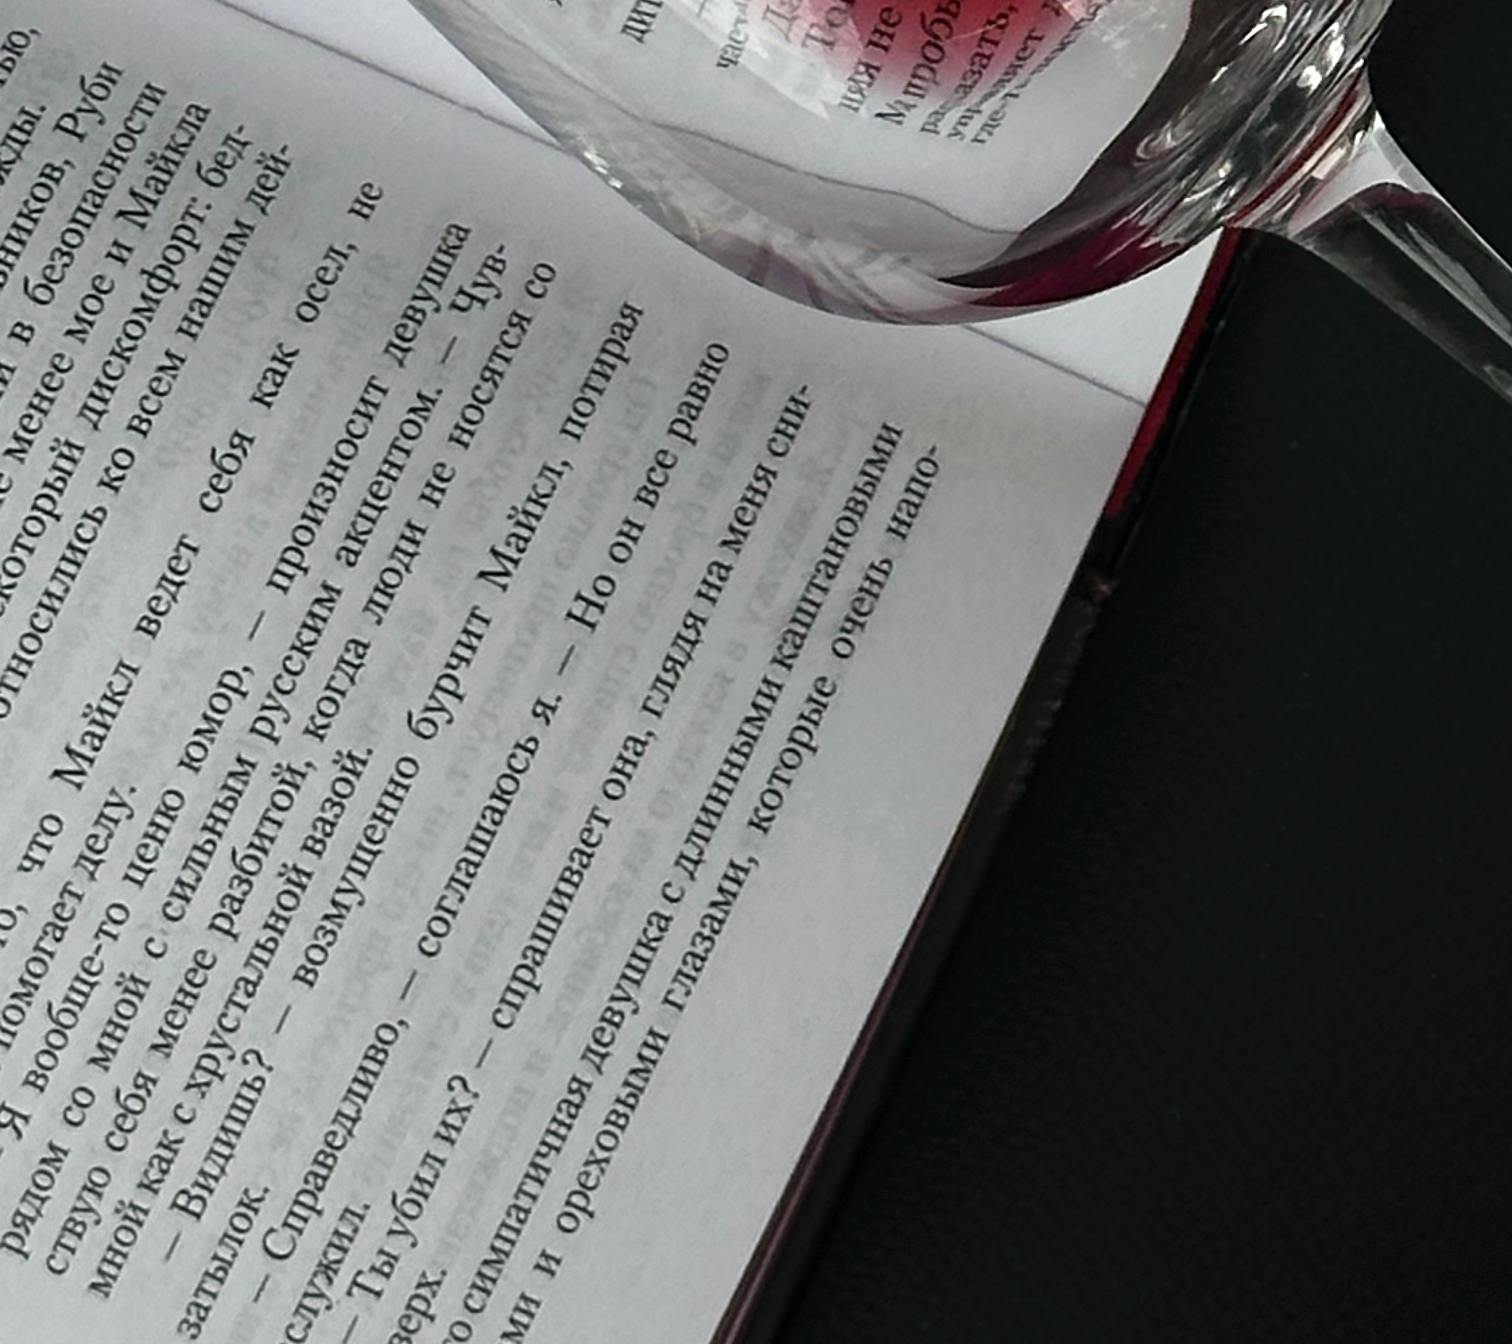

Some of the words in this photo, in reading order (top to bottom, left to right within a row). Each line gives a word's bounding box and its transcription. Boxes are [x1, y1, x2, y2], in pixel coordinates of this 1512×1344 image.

[21, 81, 169, 307] безопасности
[51, 60, 125, 145] Руби
[112, 102, 213, 232] Майкла
[6, 320, 37, 348] в
[61, 273, 116, 346] мое
[75, 195, 214, 433] дискомфорт:
[194, 124, 255, 189] бед-
[95, 446, 137, 497] ко
[124, 347, 188, 440] всем
[174, 216, 257, 343] нашим
[243, 143, 292, 218] дей-
[103, 237, 136, 269] и
[1, 351, 76, 466] менее
[15, 813, 65, 874] что
[48, 657, 142, 793] Майкл
[132, 532, 201, 641] ведет
[197, 428, 257, 515] себя
[248, 341, 301, 411] как
[294, 242, 359, 324] осел,
[346, 181, 384, 222] не
[768, 421, 905, 674] каштановыми
[1, 1101, 33, 1142] Я
[20, 901, 132, 1095] вообще-то
[121, 788, 186, 890] ценю
[175, 664, 256, 776] юмор,
[264, 374, 391, 597] произносит
[381, 222, 473, 370] девушка
[1, 1139, 71, 1262] рядом
[61, 1085, 97, 1129] со
[85, 970, 152, 1074] мной
[142, 935, 169, 961] с
[160, 752, 259, 924] сильным
[247, 578, 344, 747] русским
[333, 387, 444, 569] акцентом.
[446, 243, 508, 315] Чув-
[44, 1165, 113, 1277] ствую
[103, 1068, 160, 1154] себя
[147, 947, 219, 1060] менее
[206, 760, 318, 944] разбитой,
[300, 637, 373, 744] когда
[361, 517, 430, 627] люди
[416, 460, 457, 511] не
[446, 308, 534, 452] носятся
[523, 262, 558, 301] со
[167, 1047, 275, 1223] Видишь?
[290, 755, 421, 990] возмущенно
[405, 604, 493, 742] бурчит
[474, 459, 575, 594] Майкл,
[558, 300, 645, 443] потирая
[72, 785, 138, 883] делу.
[260, 1018, 410, 1262] Справедливо,
[416, 735, 541, 959] соглашаюсь
[530, 694, 564, 728] я.
[563, 573, 617, 635] Но
[607, 515, 647, 566] он
[631, 447, 680, 511] все
[665, 342, 730, 448] равно
[298, 747, 375, 861] вазой.
[344, 1246, 401, 1301] Ты
[385, 1149, 448, 1250] убил
[432, 1073, 481, 1149] их?
[490, 804, 613, 1031] спрашивает
[600, 729, 658, 802] она,
[639, 608, 710, 721] глядя
[693, 559, 735, 608] на
[716, 461, 780, 557] меня
[765, 383, 813, 459] сни-
[531, 1247, 564, 1280] и
[555, 1025, 671, 1235] ореховыми
[660, 855, 760, 1014] глазами,
[745, 675, 838, 836] которые
[830, 556, 894, 661] очень
[884, 444, 940, 543] напо-
[672, 673, 786, 883] длинными
[182, 861, 316, 1101] хрустальной
[660, 880, 687, 906] с
[578, 909, 675, 1077] девушка
[135, 1128, 186, 1197] как
[171, 1101, 197, 1127] с
[462, 1072, 595, 1316] симпатичная
[86, 1198, 152, 1300] мной
[176, 1186, 271, 1341] затылок.
[283, 1202, 372, 1343] служил.
